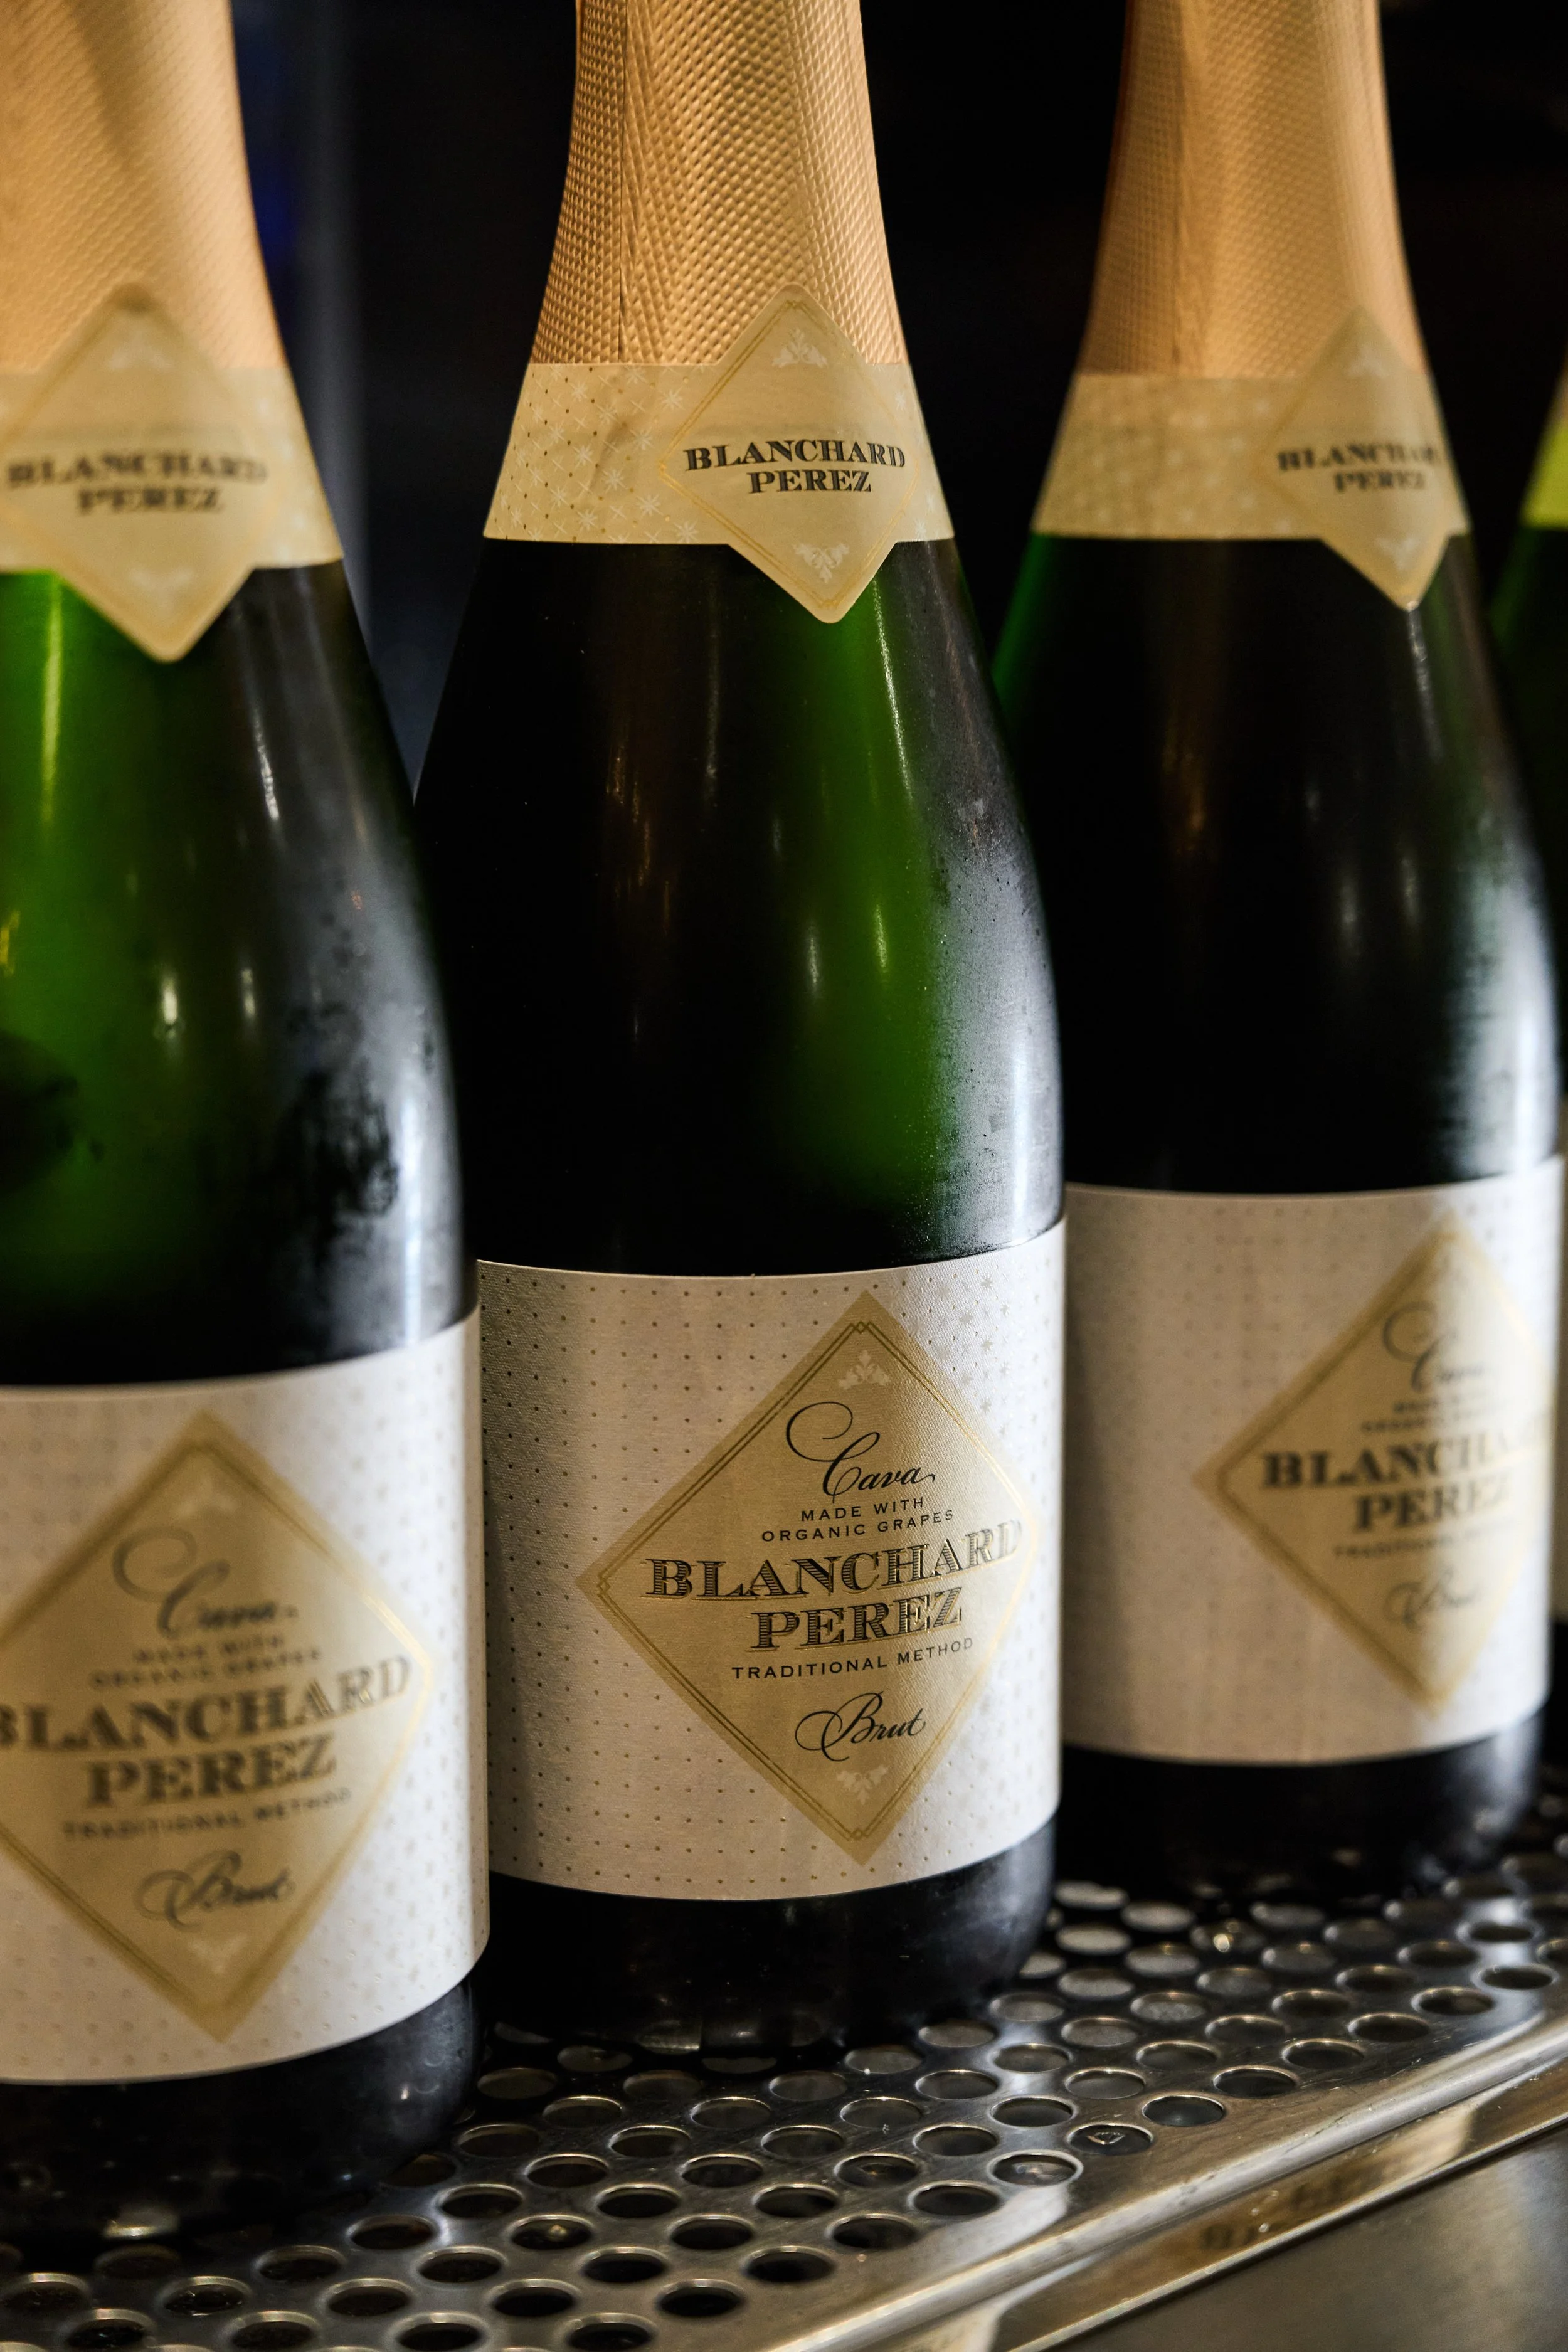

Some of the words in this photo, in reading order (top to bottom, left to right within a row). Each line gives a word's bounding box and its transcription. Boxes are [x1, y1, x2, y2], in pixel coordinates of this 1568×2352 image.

[683, 439, 905, 471] BLANCHARD
[748, 469, 871, 494] PEREZ
[786, 1401, 936, 1503] Cava
[761, 1524, 866, 1542] ORGANIC
[877, 1509, 955, 1535] GRAPES
[802, 1507, 862, 1522] MADE
[873, 1496, 925, 1515] WITH
[644, 1519, 1022, 1600] BLANCHARD
[749, 1587, 963, 1651] PEREZ
[732, 1656, 887, 1679] TRADITIONAL
[898, 1636, 974, 1665] METHOD
[795, 1690, 926, 1762] Brut
[84, 1732, 336, 1809] PEREZ
